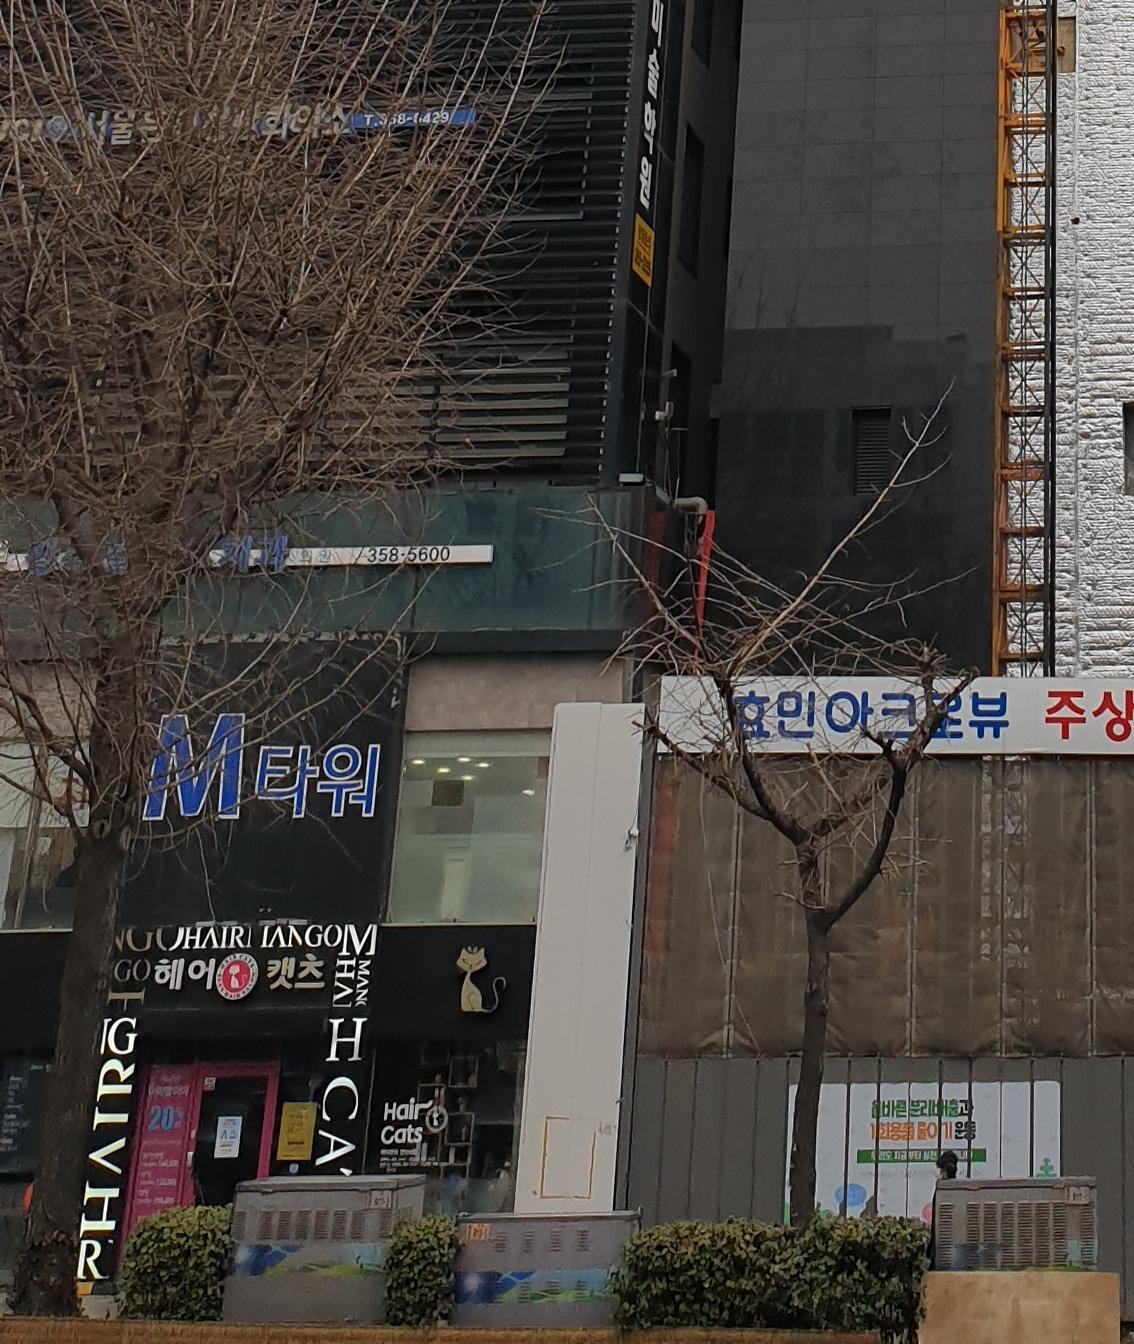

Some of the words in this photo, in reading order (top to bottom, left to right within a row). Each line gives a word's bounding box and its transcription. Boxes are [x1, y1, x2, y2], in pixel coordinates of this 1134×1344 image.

[366, 546, 451, 563] 358-5600
[154, 957, 216, 990] 헤어
[266, 953, 326, 991] 캣츠
[383, 1096, 434, 1121] Hair
[380, 1124, 424, 1145] Cats
